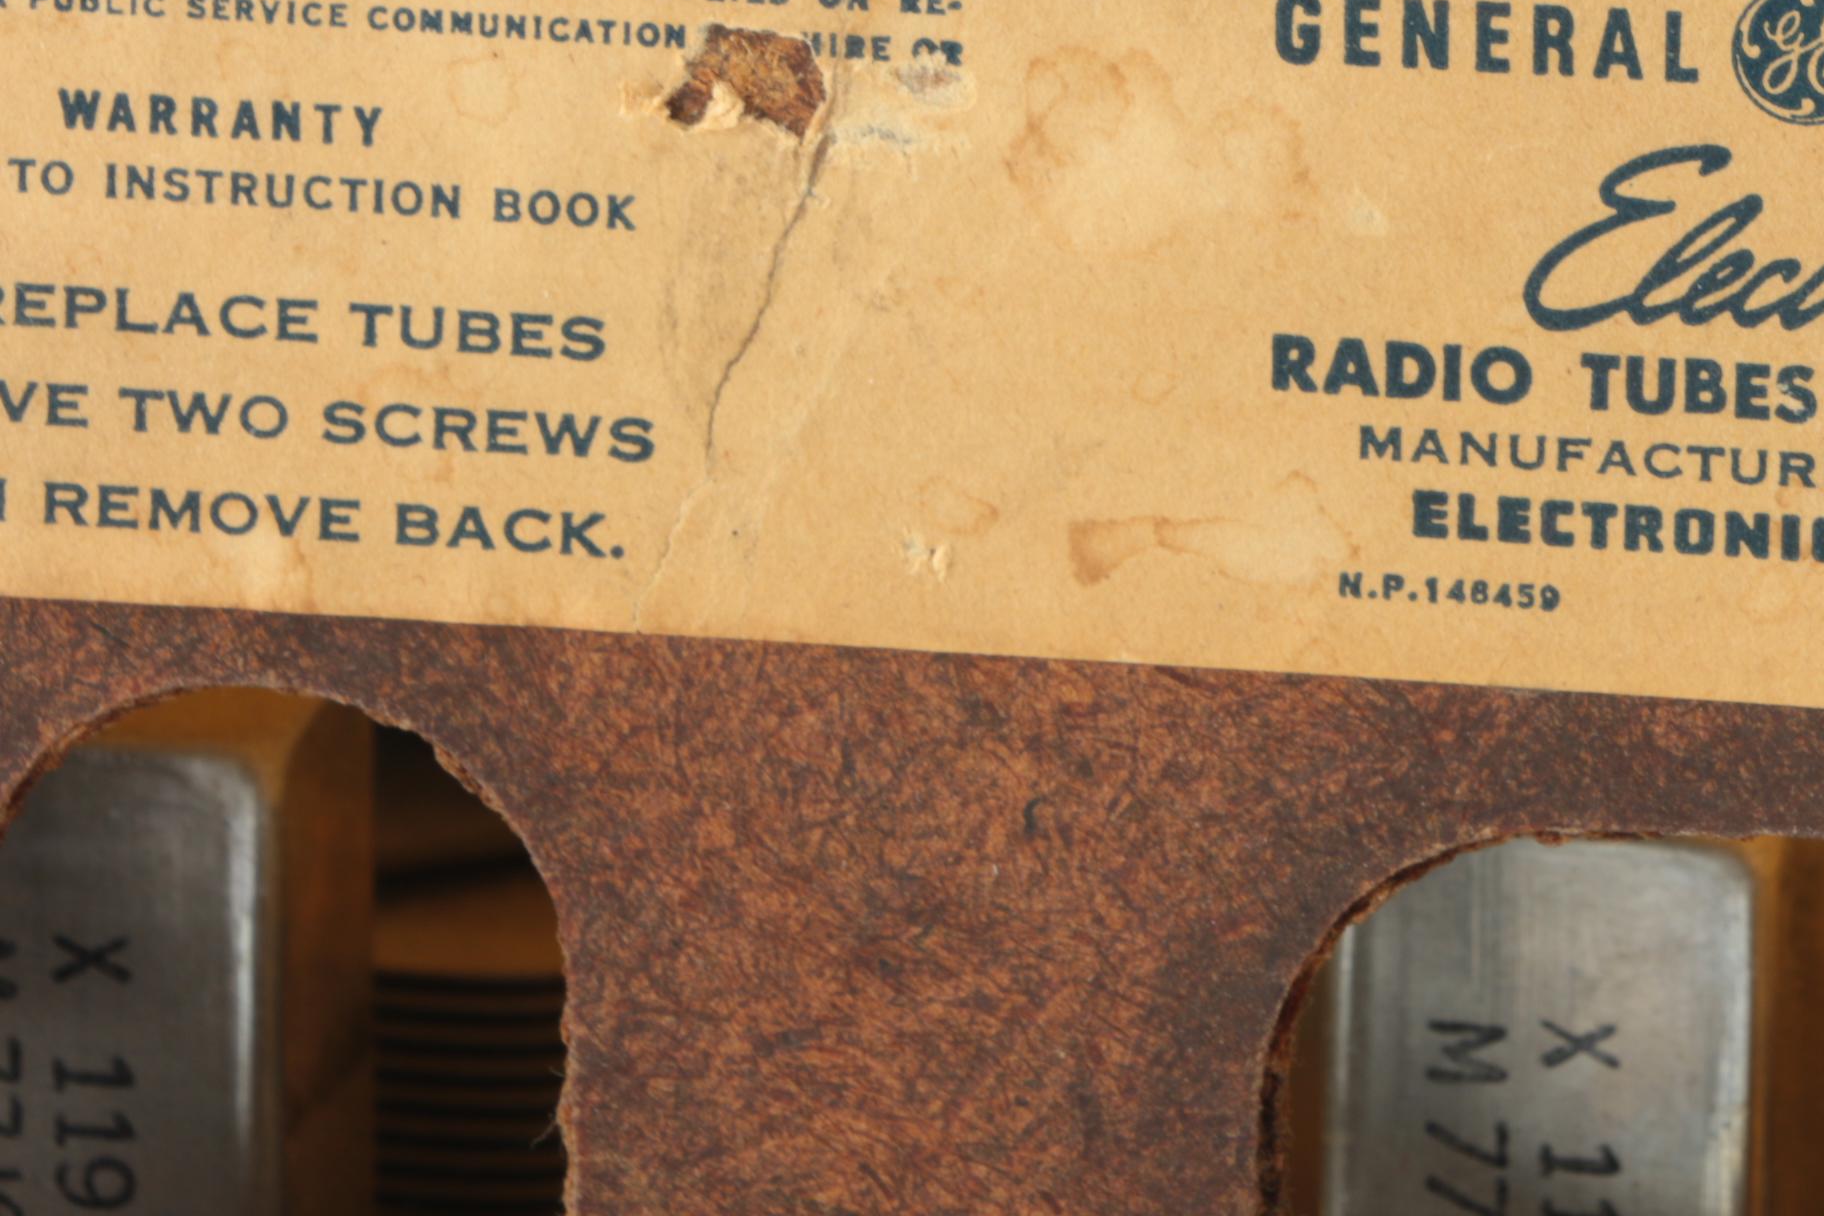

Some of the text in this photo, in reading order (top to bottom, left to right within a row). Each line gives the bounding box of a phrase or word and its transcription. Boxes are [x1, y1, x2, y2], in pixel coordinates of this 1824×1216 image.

[367, 5, 687, 49] COMMUNICATION
[59, 88, 383, 147] WARRANTY
[9, 158, 636, 230] TO INSTRUCTION BOOK
[350, 302, 606, 361] TUBES
[1272, 333, 1534, 405] RADIO
[1581, 352, 1818, 424] TUBES
[119, 387, 290, 438] TWO
[323, 400, 656, 463] SCREWS
[45, 481, 362, 542] REMOVE
[396, 503, 625, 558] BACK.
[52, 932, 134, 984] X
[1425, 1018, 1508, 1084] M
[1540, 1017, 1621, 1070] X
